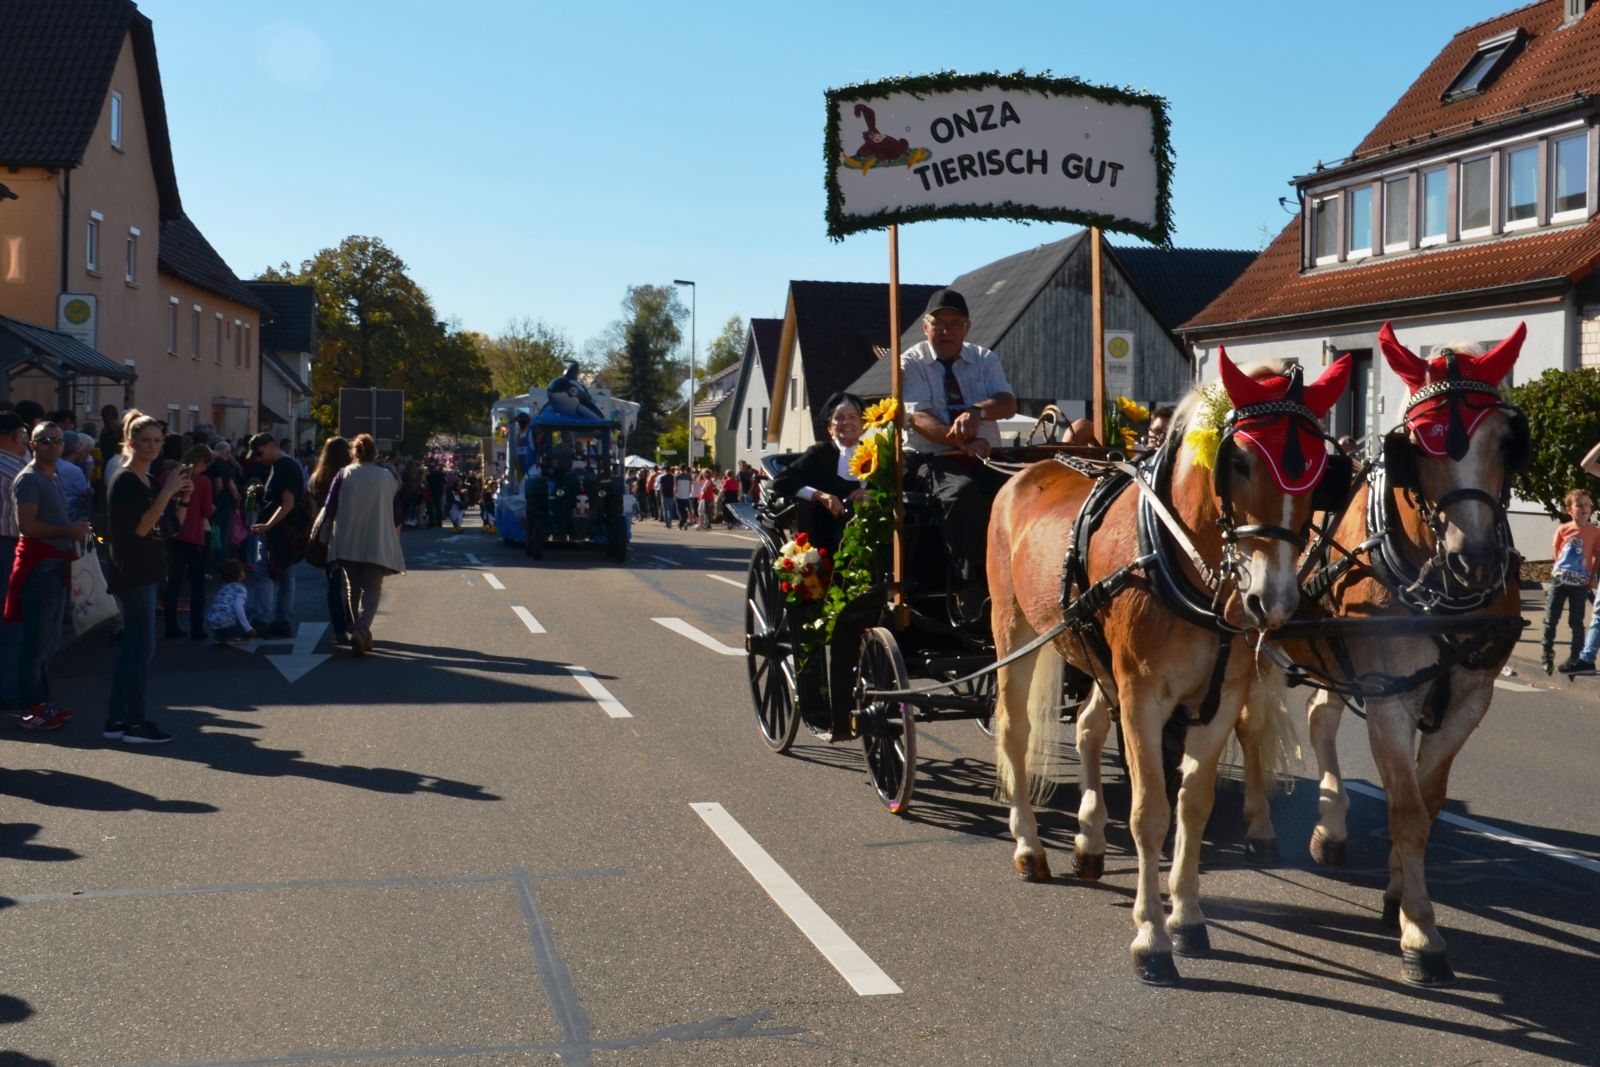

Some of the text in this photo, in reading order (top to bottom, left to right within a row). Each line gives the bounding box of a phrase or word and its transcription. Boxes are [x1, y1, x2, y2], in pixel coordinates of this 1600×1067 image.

[929, 100, 1022, 144] ONZA
[912, 148, 1125, 192] TIERISCH GUT
